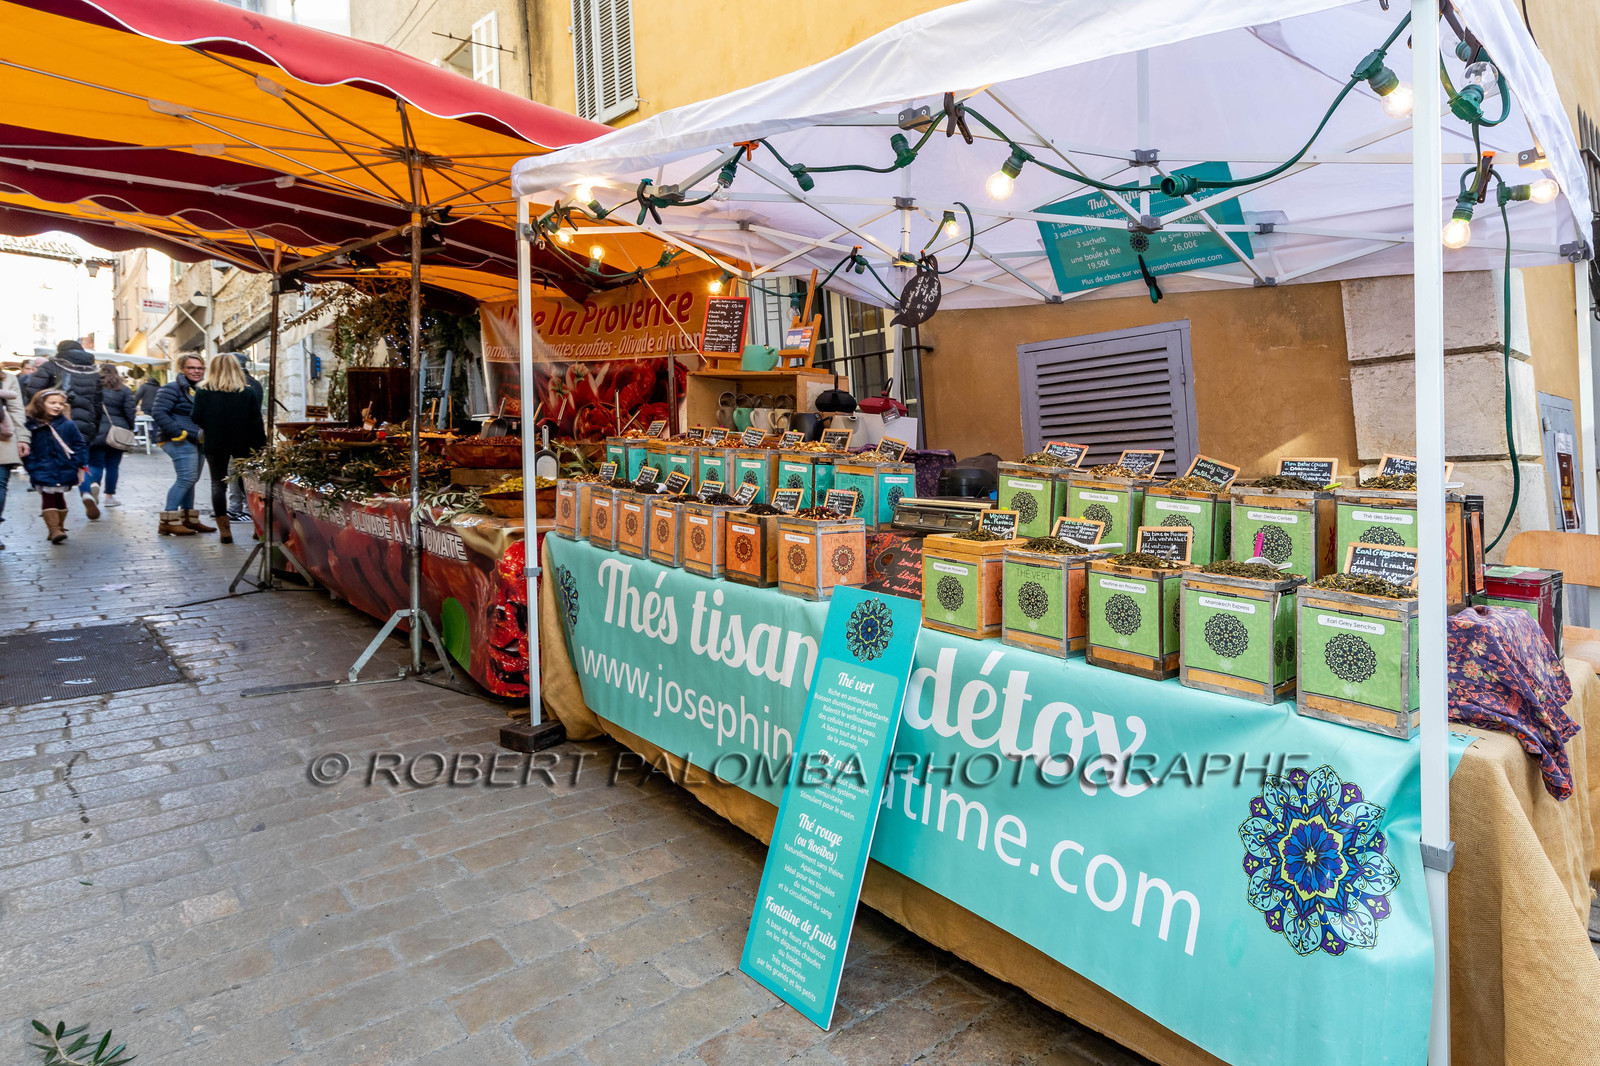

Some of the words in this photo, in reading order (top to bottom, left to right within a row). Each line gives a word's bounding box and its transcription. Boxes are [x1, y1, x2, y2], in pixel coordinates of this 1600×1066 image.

[1088, 197, 1108, 210] Thés
[1060, 227, 1083, 238] sachets
[1082, 236, 1106, 246] sachets
[1172, 240, 1198, 252] 26,00€
[1084, 252, 1102, 260] boule
[1110, 246, 1120, 254] thé
[1088, 259, 1110, 270] 19,50€
[1104, 272, 1121, 280] choix
[548, 301, 578, 336] la
[578, 291, 693, 335] Provence
[574, 338, 611, 357] confites
[656, 330, 664, 351] à
[666, 330, 676, 352] la
[1197, 459, 1214, 474] Lovely
[351, 510, 392, 540] OLIVADE
[420, 526, 467, 560] TOMATE
[1356, 546, 1372, 556] Earl
[1372, 548, 1390, 559] Grey
[952, 566, 967, 574] Provence
[1390, 562, 1414, 572] matin
[1016, 568, 1030, 578] THÉ
[1032, 571, 1050, 581] VERT
[1125, 583, 1144, 591] Provence
[1206, 600, 1231, 608] Marrakech
[1232, 604, 1250, 612] Express
[1326, 616, 1338, 624] Earl
[1338, 619, 1352, 628] Grey
[1354, 621, 1376, 630] Sencha
[598, 558, 678, 644] Thés
[690, 589, 819, 693] tisan
[904, 648, 1160, 797] détox
[838, 672, 856, 688] Thé
[855, 681, 874, 694] vert
[828, 688, 840, 697] Riche
[814, 693, 831, 703] Boisson
[832, 699, 855, 711] diurétique
[827, 717, 843, 726] cellules
[826, 724, 838, 734] boire
[839, 729, 849, 738] tout
[857, 735, 868, 746] long
[818, 749, 836, 767] Thé
[834, 760, 855, 774] noir
[800, 790, 822, 805] Stimulant
[822, 802, 834, 811] pour
[837, 788, 856, 800] système
[799, 813, 816, 832] Thé
[815, 825, 842, 847] rouge
[794, 833, 807, 847] (ou
[784, 843, 816, 864] Naturellement
[817, 862, 827, 871] sans
[794, 880, 800, 888] du
[801, 885, 821, 899] sommeil
[796, 872, 807, 881] pour
[815, 882, 835, 897] troubles
[784, 884, 788, 892] la
[789, 889, 812, 906] circulation
[813, 902, 820, 911] du
[820, 907, 832, 919] sang
[766, 896, 800, 927] Fontaine
[800, 920, 811, 934] de
[809, 925, 836, 950] fruits
[771, 920, 781, 932] base
[782, 928, 788, 936] de
[789, 931, 802, 945] fleurs
[772, 954, 780, 965] Très
[778, 949, 785, 957] ou
[801, 952, 821, 969] chaudes
[772, 968, 788, 982] grands
[802, 988, 816, 1002] petits
